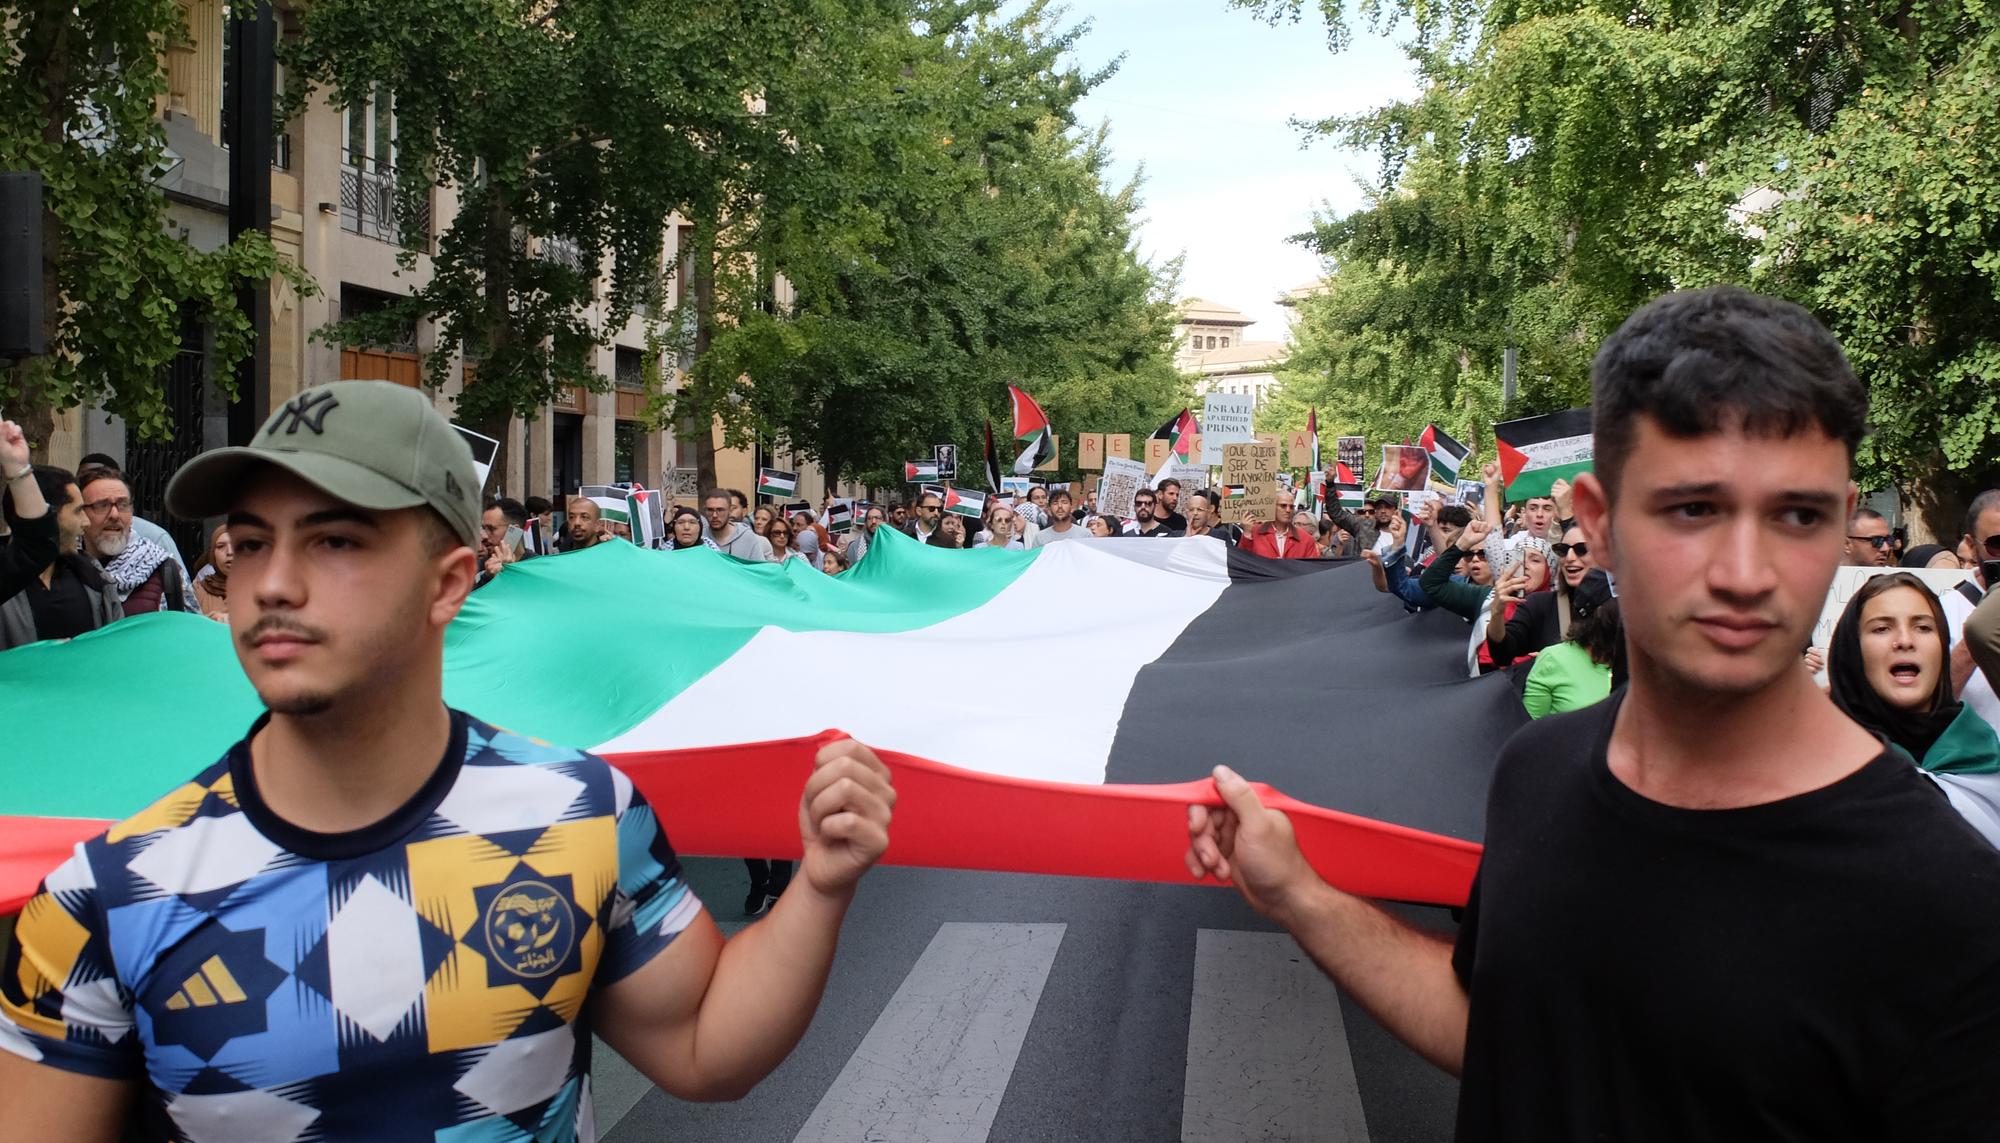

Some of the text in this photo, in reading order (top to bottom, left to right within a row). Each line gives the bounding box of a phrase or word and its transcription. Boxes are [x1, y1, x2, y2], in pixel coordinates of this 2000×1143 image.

[267, 389, 340, 435] NY
[1208, 404, 1250, 415] ISRAEL
[1207, 415, 1249, 423] APARTHEID
[1206, 424, 1248, 434] PRISON
[1228, 458, 1269, 472] SER DE
[1264, 471, 1276, 482] EN
[1246, 486, 1261, 496] NO
